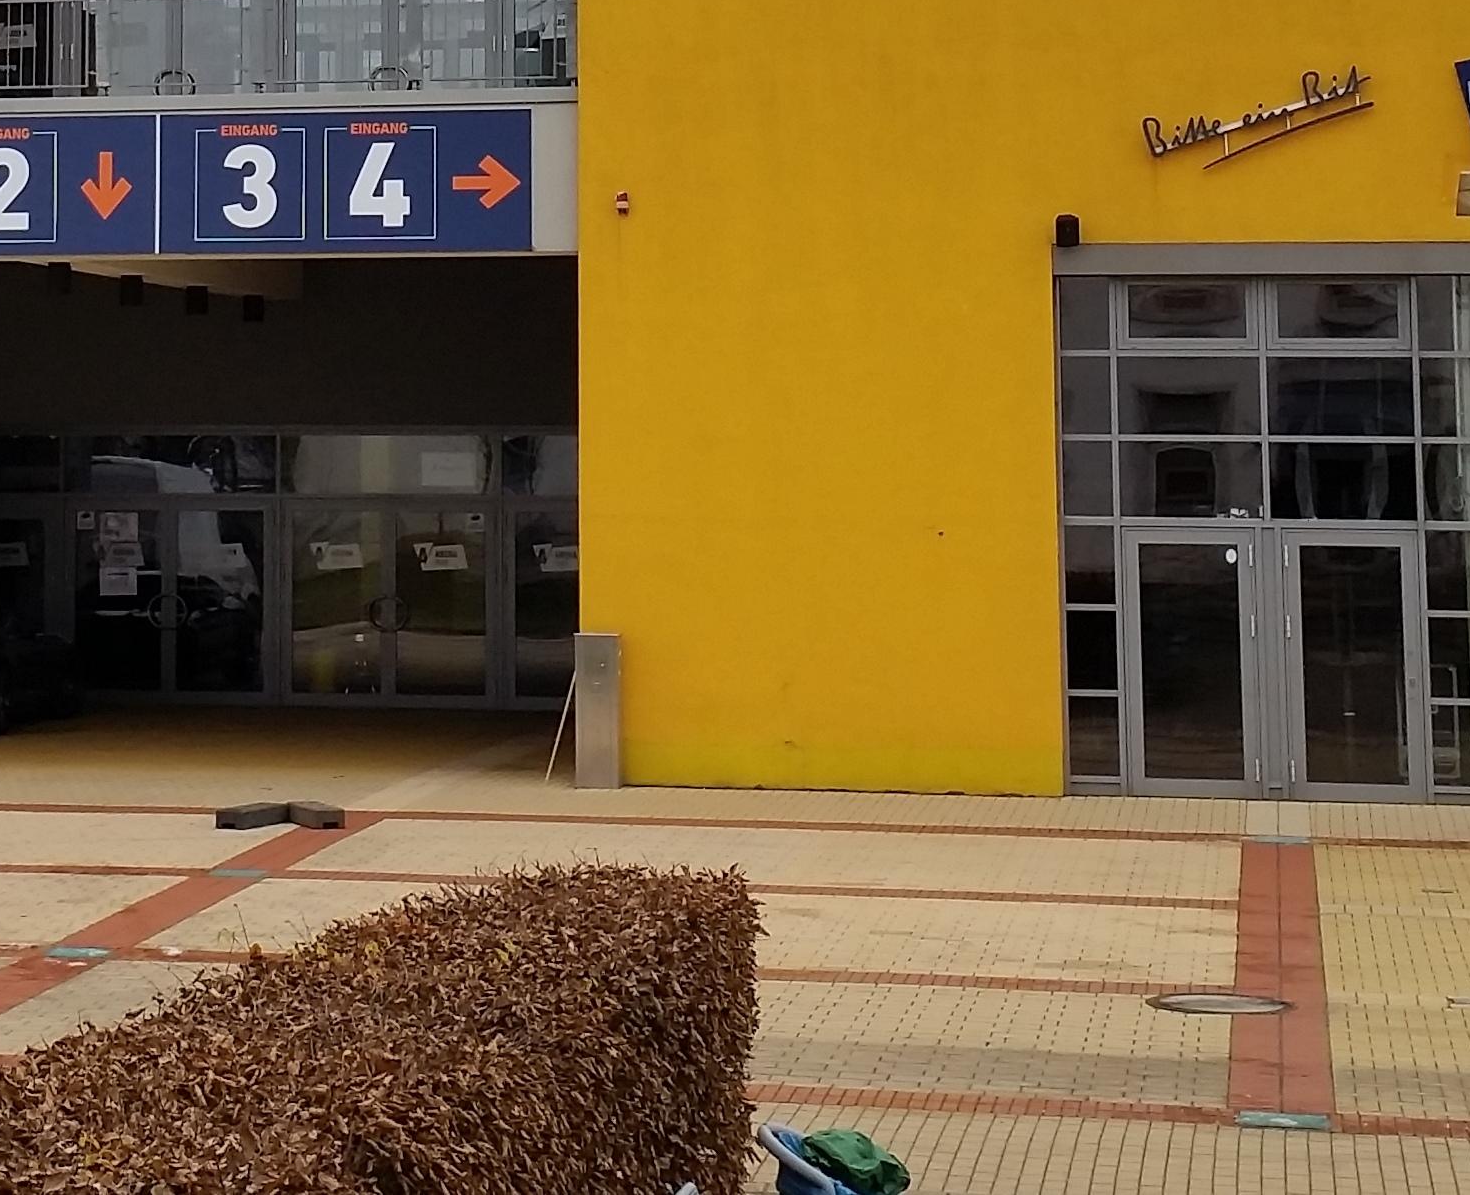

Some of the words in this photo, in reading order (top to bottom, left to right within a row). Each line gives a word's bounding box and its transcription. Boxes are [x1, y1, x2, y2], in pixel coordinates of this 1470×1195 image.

[220, 124, 278, 136] EINGANG
[350, 122, 408, 135] EINGANG
[222, 144, 278, 229] 3
[348, 141, 411, 227] 4
